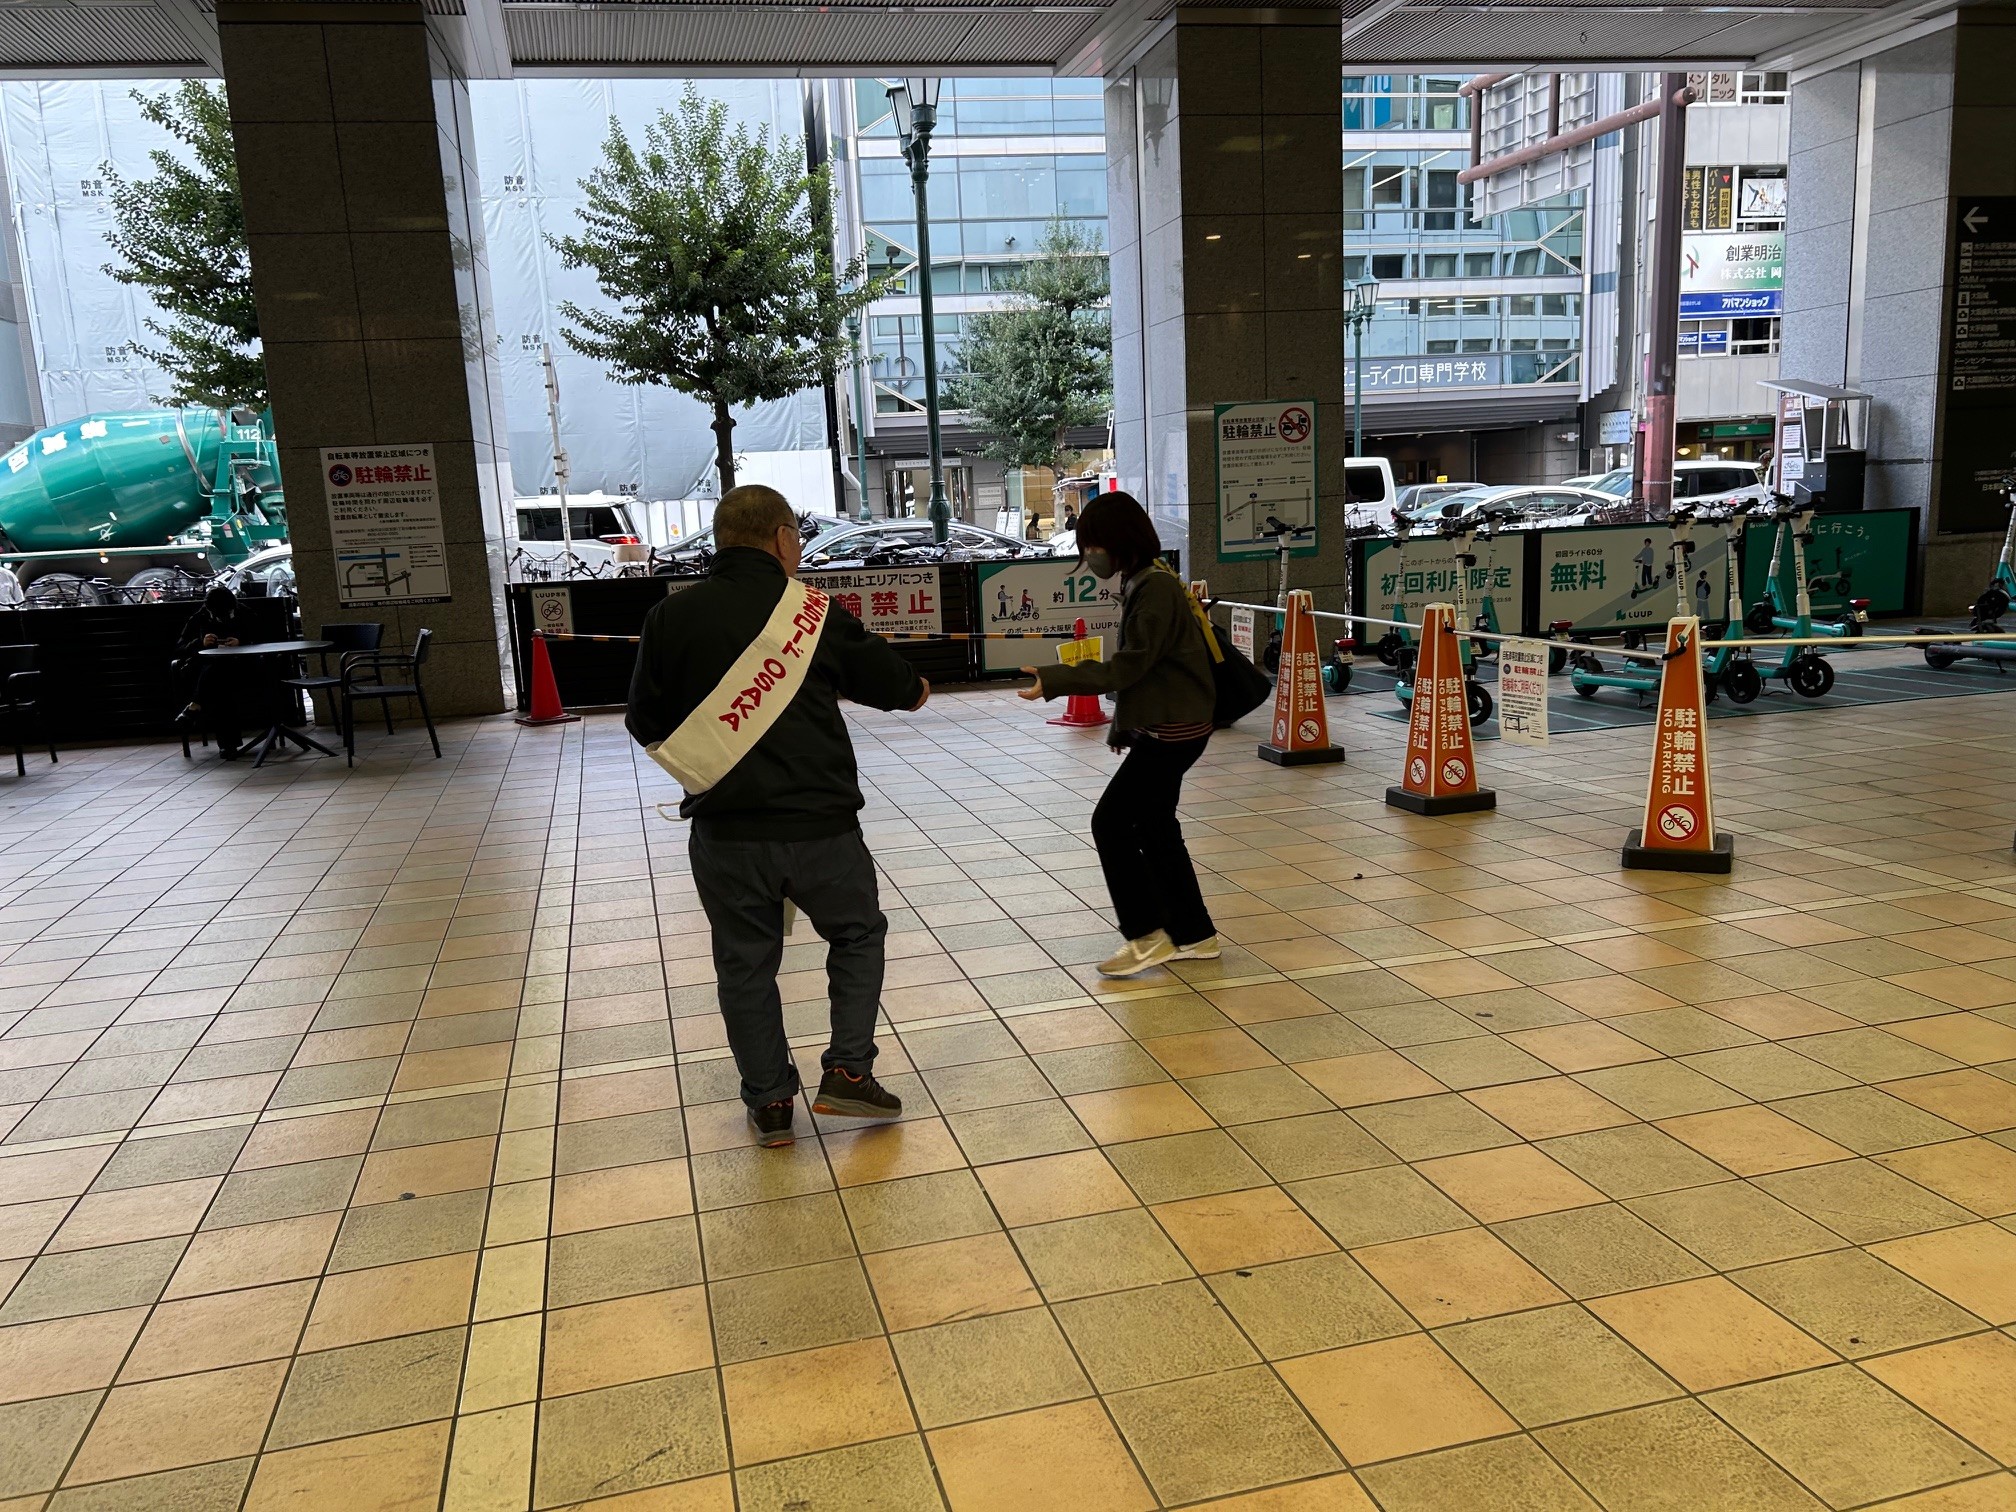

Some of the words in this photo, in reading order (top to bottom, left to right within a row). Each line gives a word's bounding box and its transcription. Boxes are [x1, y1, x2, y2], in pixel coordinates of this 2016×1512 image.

[1688, 73, 1730, 85] メンタル
[1694, 88, 1735, 99] リニック
[80, 180, 103, 190] 防音
[504, 175, 525, 185] 防音
[1690, 170, 1701, 228] 男性も女性も
[1707, 169, 1718, 228] パーソナルジム
[1725, 244, 1782, 261] 創業明治
[1720, 267, 1767, 279] 株式会社
[1722, 296, 1770, 308] アパマンショップ
[521, 334, 541, 344] 防音
[105, 346, 128, 356] 防音
[1344, 361, 1487, 386] ーティプロ専門学校
[236, 428, 260, 439] 112
[1222, 423, 1277, 438] 駐輪禁止
[327, 449, 429, 461] 自転車等放置禁止区域につき
[355, 464, 432, 484] 駐輪禁止
[540, 486, 559, 495] 防音
[619, 483, 638, 491] 防音
[1555, 548, 1603, 558] 初回ライド60分
[798, 572, 934, 590] 等放置禁止エリアにつき
[1380, 566, 1511, 596] 初回利用限定
[1550, 559, 1607, 592] 無料
[1053, 576, 1110, 603] 約12分
[1296, 653, 1302, 666] NO
[1514, 665, 1545, 676] 駐輪禁止
[1280, 652, 1292, 712] 駐輪禁止
[1296, 669, 1304, 712] PARKING
[1302, 652, 1318, 712] 駐輪禁止
[1439, 679, 1445, 695] NO
[719, 658, 786, 732] OSAKA
[1413, 697, 1421, 747] PARKING
[1417, 677, 1432, 750] 駐輪禁止
[1445, 677, 1464, 750] 駐輪禁止
[1663, 709, 1673, 728] NO
[1440, 698, 1449, 750] PARKING
[1673, 708, 1697, 796] 駐輪禁止
[1662, 732, 1673, 794] PARKING
